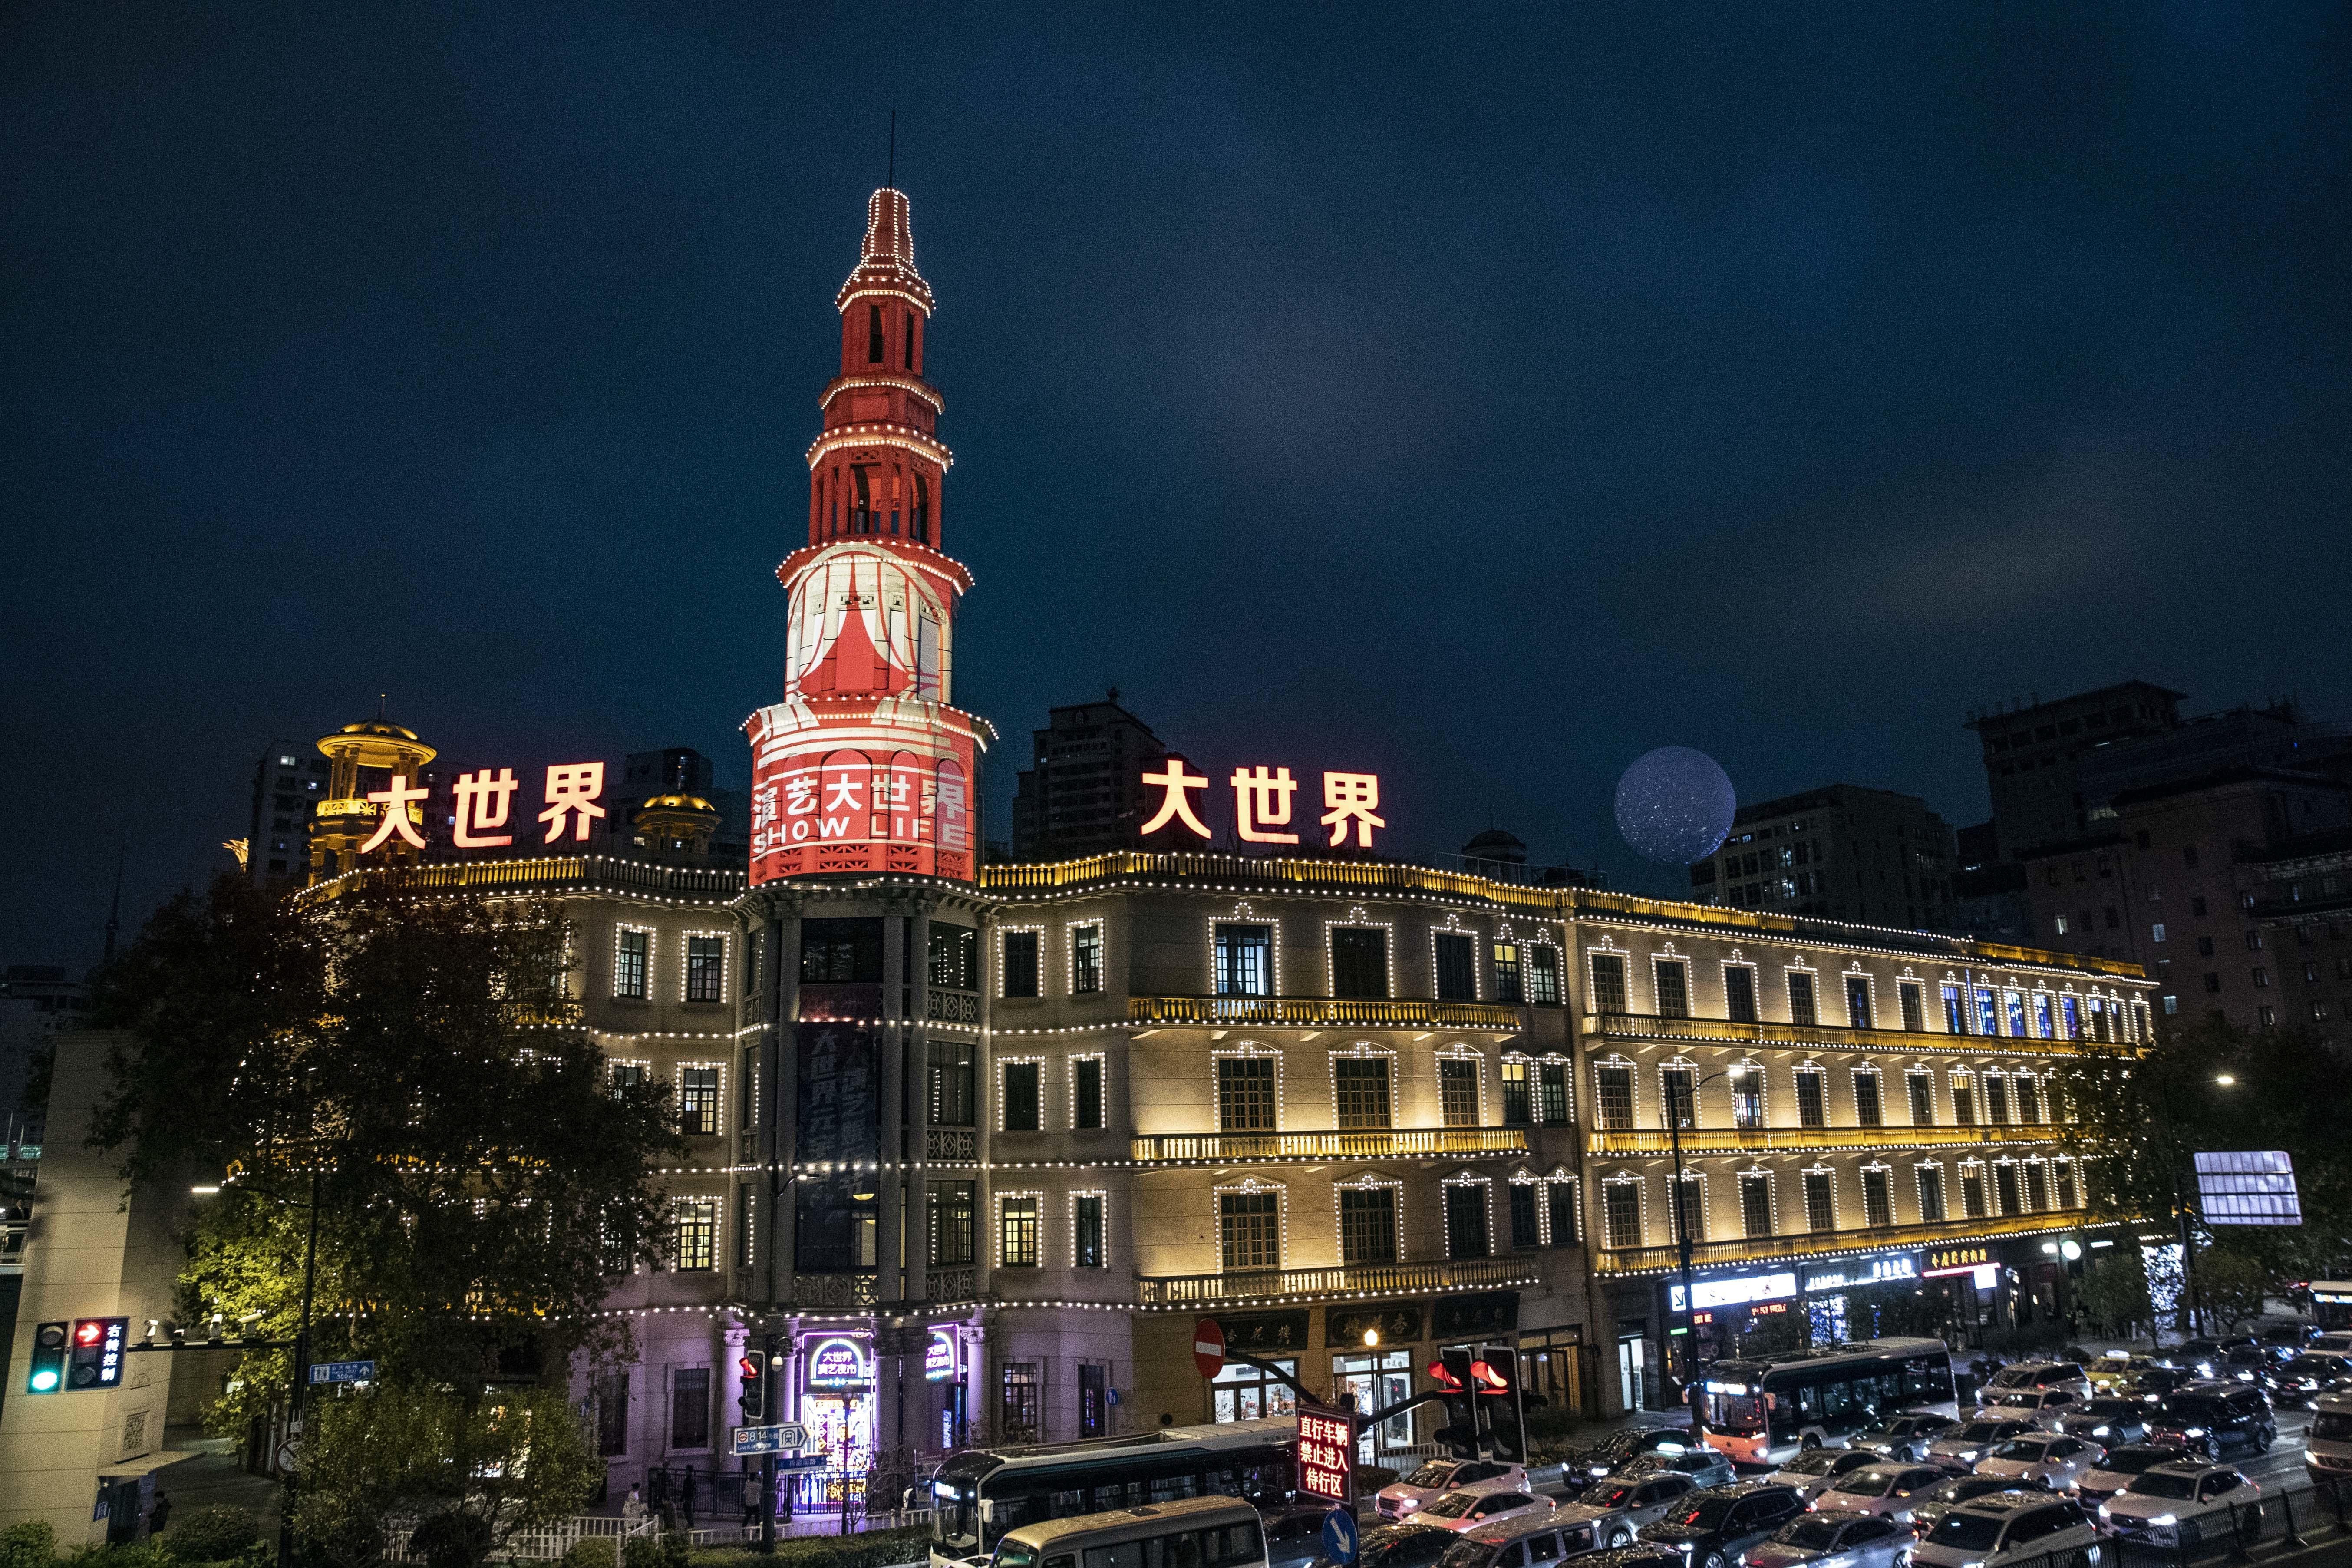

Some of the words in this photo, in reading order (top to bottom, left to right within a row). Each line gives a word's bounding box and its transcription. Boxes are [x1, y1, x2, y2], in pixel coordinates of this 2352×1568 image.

[361, 761, 606, 854] 大世界
[752, 773, 966, 830] 演艺大世界
[1140, 759, 1385, 848] 大世界
[753, 816, 850, 853] SHOW
[871, 816, 966, 850] LIFE
[101, 1324, 122, 1381] 右转控制
[823, 1352, 852, 1362] 大世界
[818, 1364, 857, 1375] 演艺夜市
[749, 1432, 755, 1441] 8
[758, 1431, 767, 1441] 14
[1300, 1416, 1348, 1447] 直行车辆
[1300, 1440, 1348, 1472] 禁止进入
[1306, 1466, 1343, 1497] 待行区
